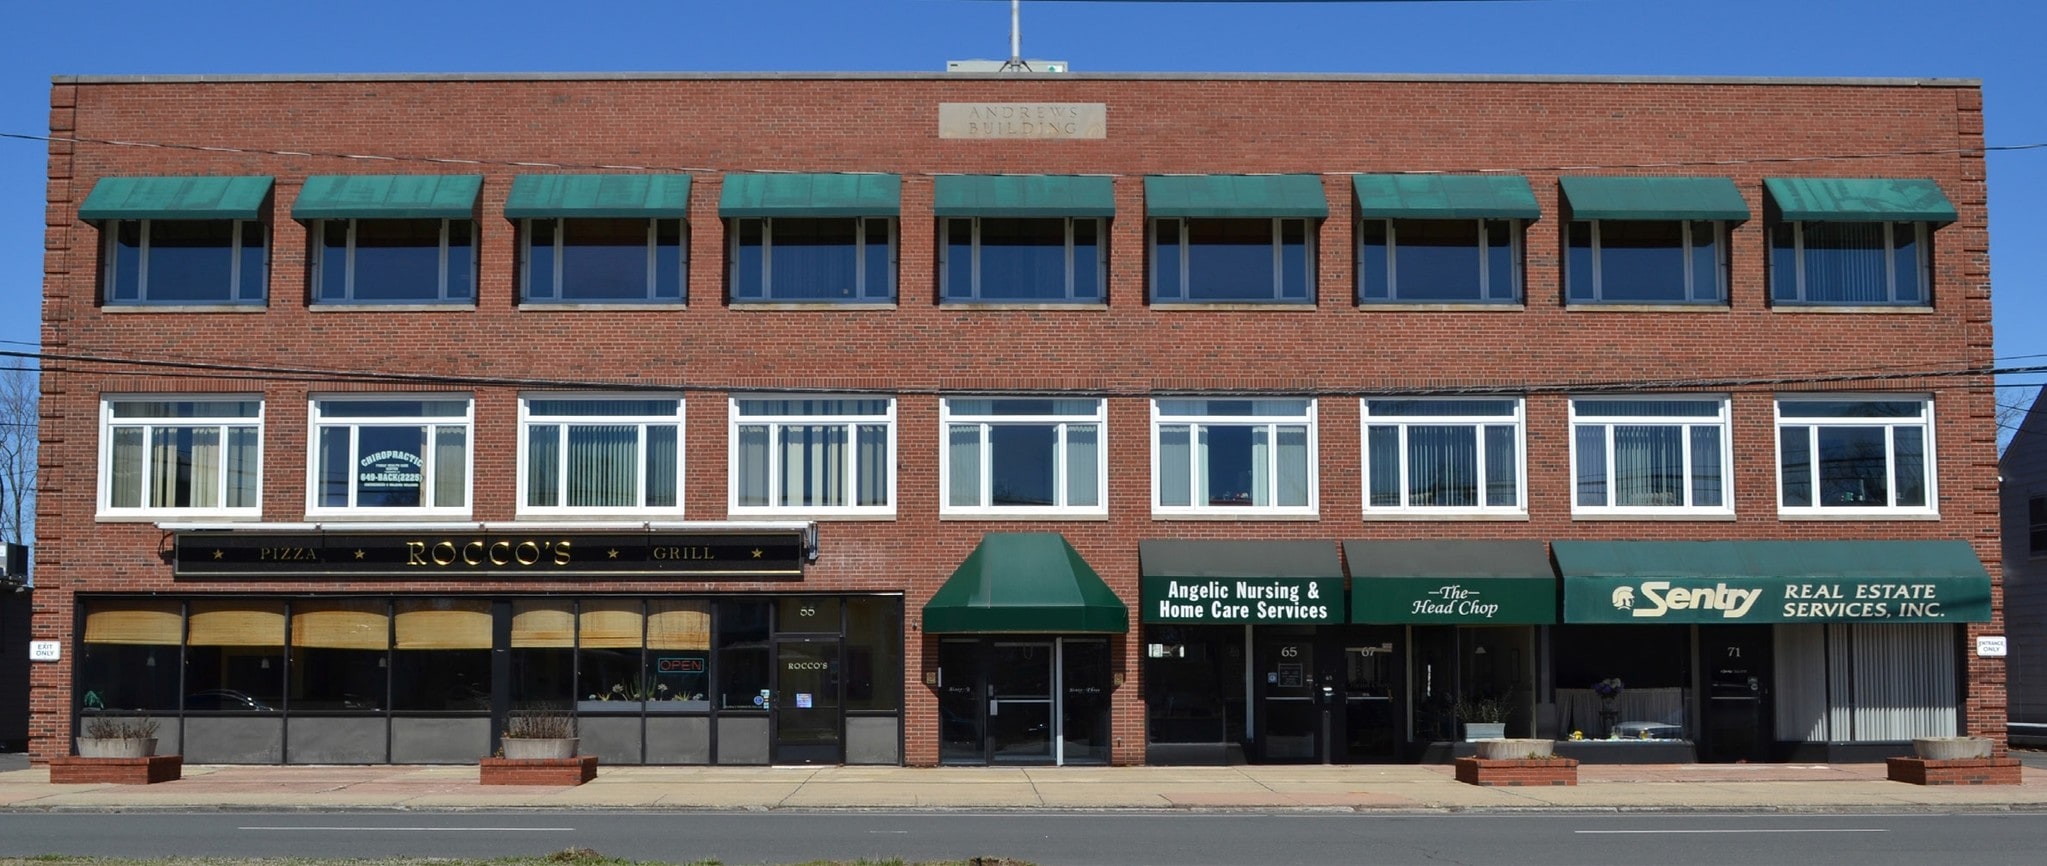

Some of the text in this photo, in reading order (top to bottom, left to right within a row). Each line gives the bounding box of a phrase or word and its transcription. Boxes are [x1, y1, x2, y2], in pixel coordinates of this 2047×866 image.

[969, 106, 1078, 119] ANDREWS
[969, 122, 1076, 134] BUILDING
[361, 450, 423, 467] CHIROPRACTIC
[260, 541, 715, 566] PIZZA ROCCO'S GRILL
[1168, 581, 1319, 602] Angelic Nursing &
[1784, 584, 1936, 599] REAL ESTATE
[1632, 581, 1763, 618] Sentry
[1160, 600, 1328, 618] Home Care Services
[1412, 599, 1499, 618] Head Chop
[1783, 602, 1945, 618] SERVICES, INC.
[1281, 646, 1298, 658] 65
[1361, 646, 1377, 657] 67
[1727, 646, 1741, 657] 71
[660, 660, 701, 671] OPEN
[788, 662, 828, 670] ROCCO'S
